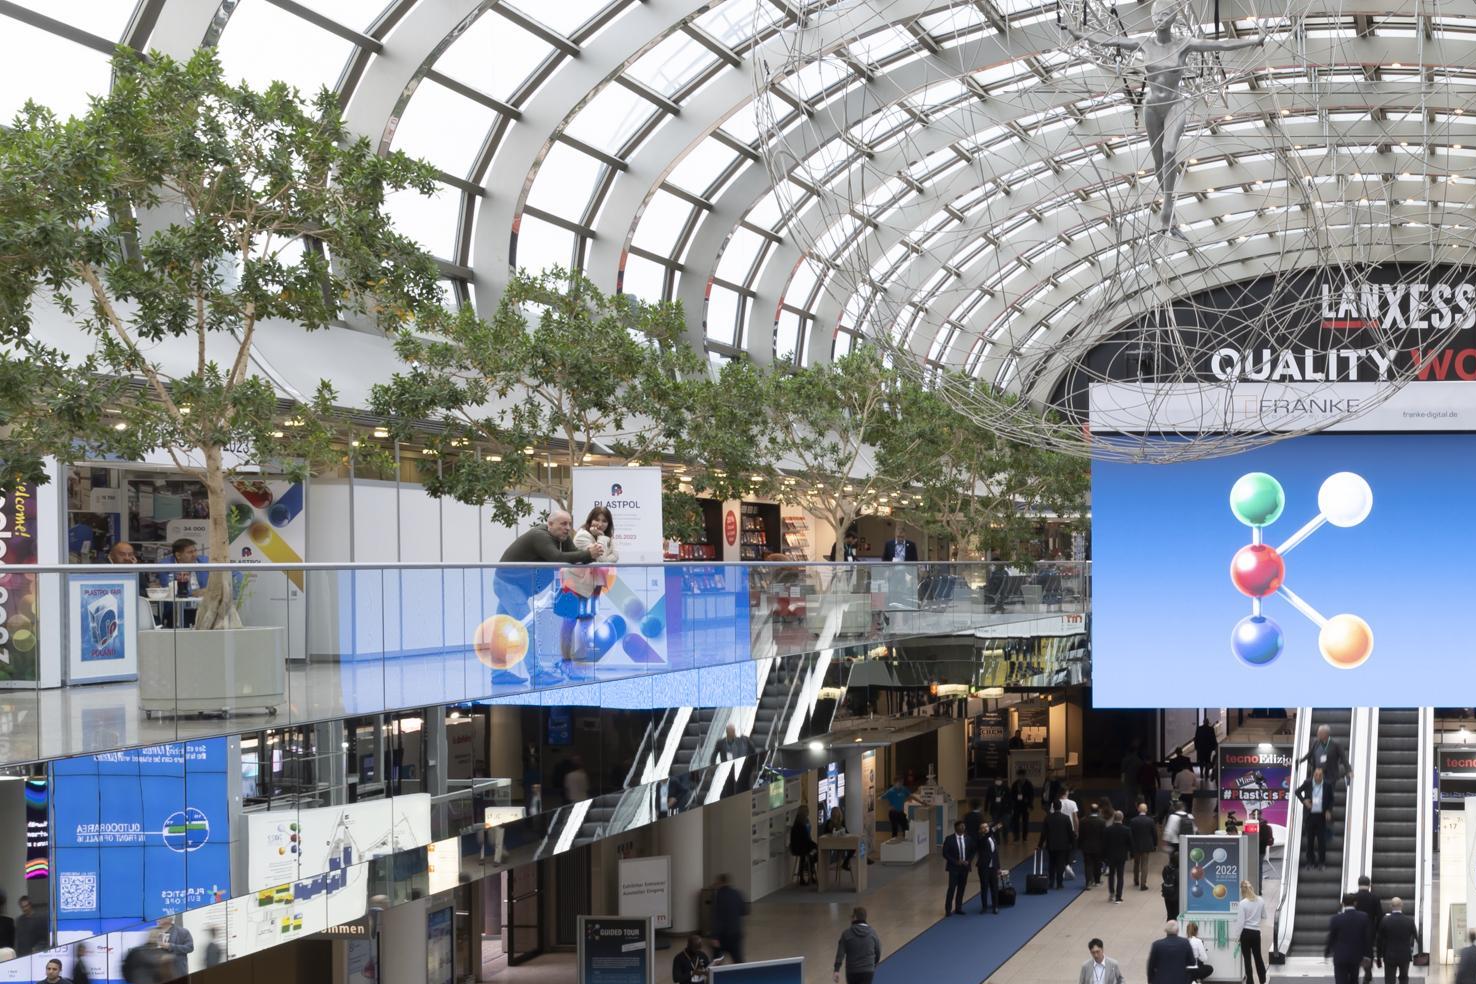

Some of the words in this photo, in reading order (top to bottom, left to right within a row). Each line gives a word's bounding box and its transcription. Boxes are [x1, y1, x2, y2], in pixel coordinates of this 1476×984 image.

[1321, 283, 1476, 330] LANXESS
[1210, 348, 1398, 382] QUALITY
[1260, 399, 1360, 414] FRANKE
[14, 479, 31, 539] elcome!
[1215, 865, 1237, 875] 2022
